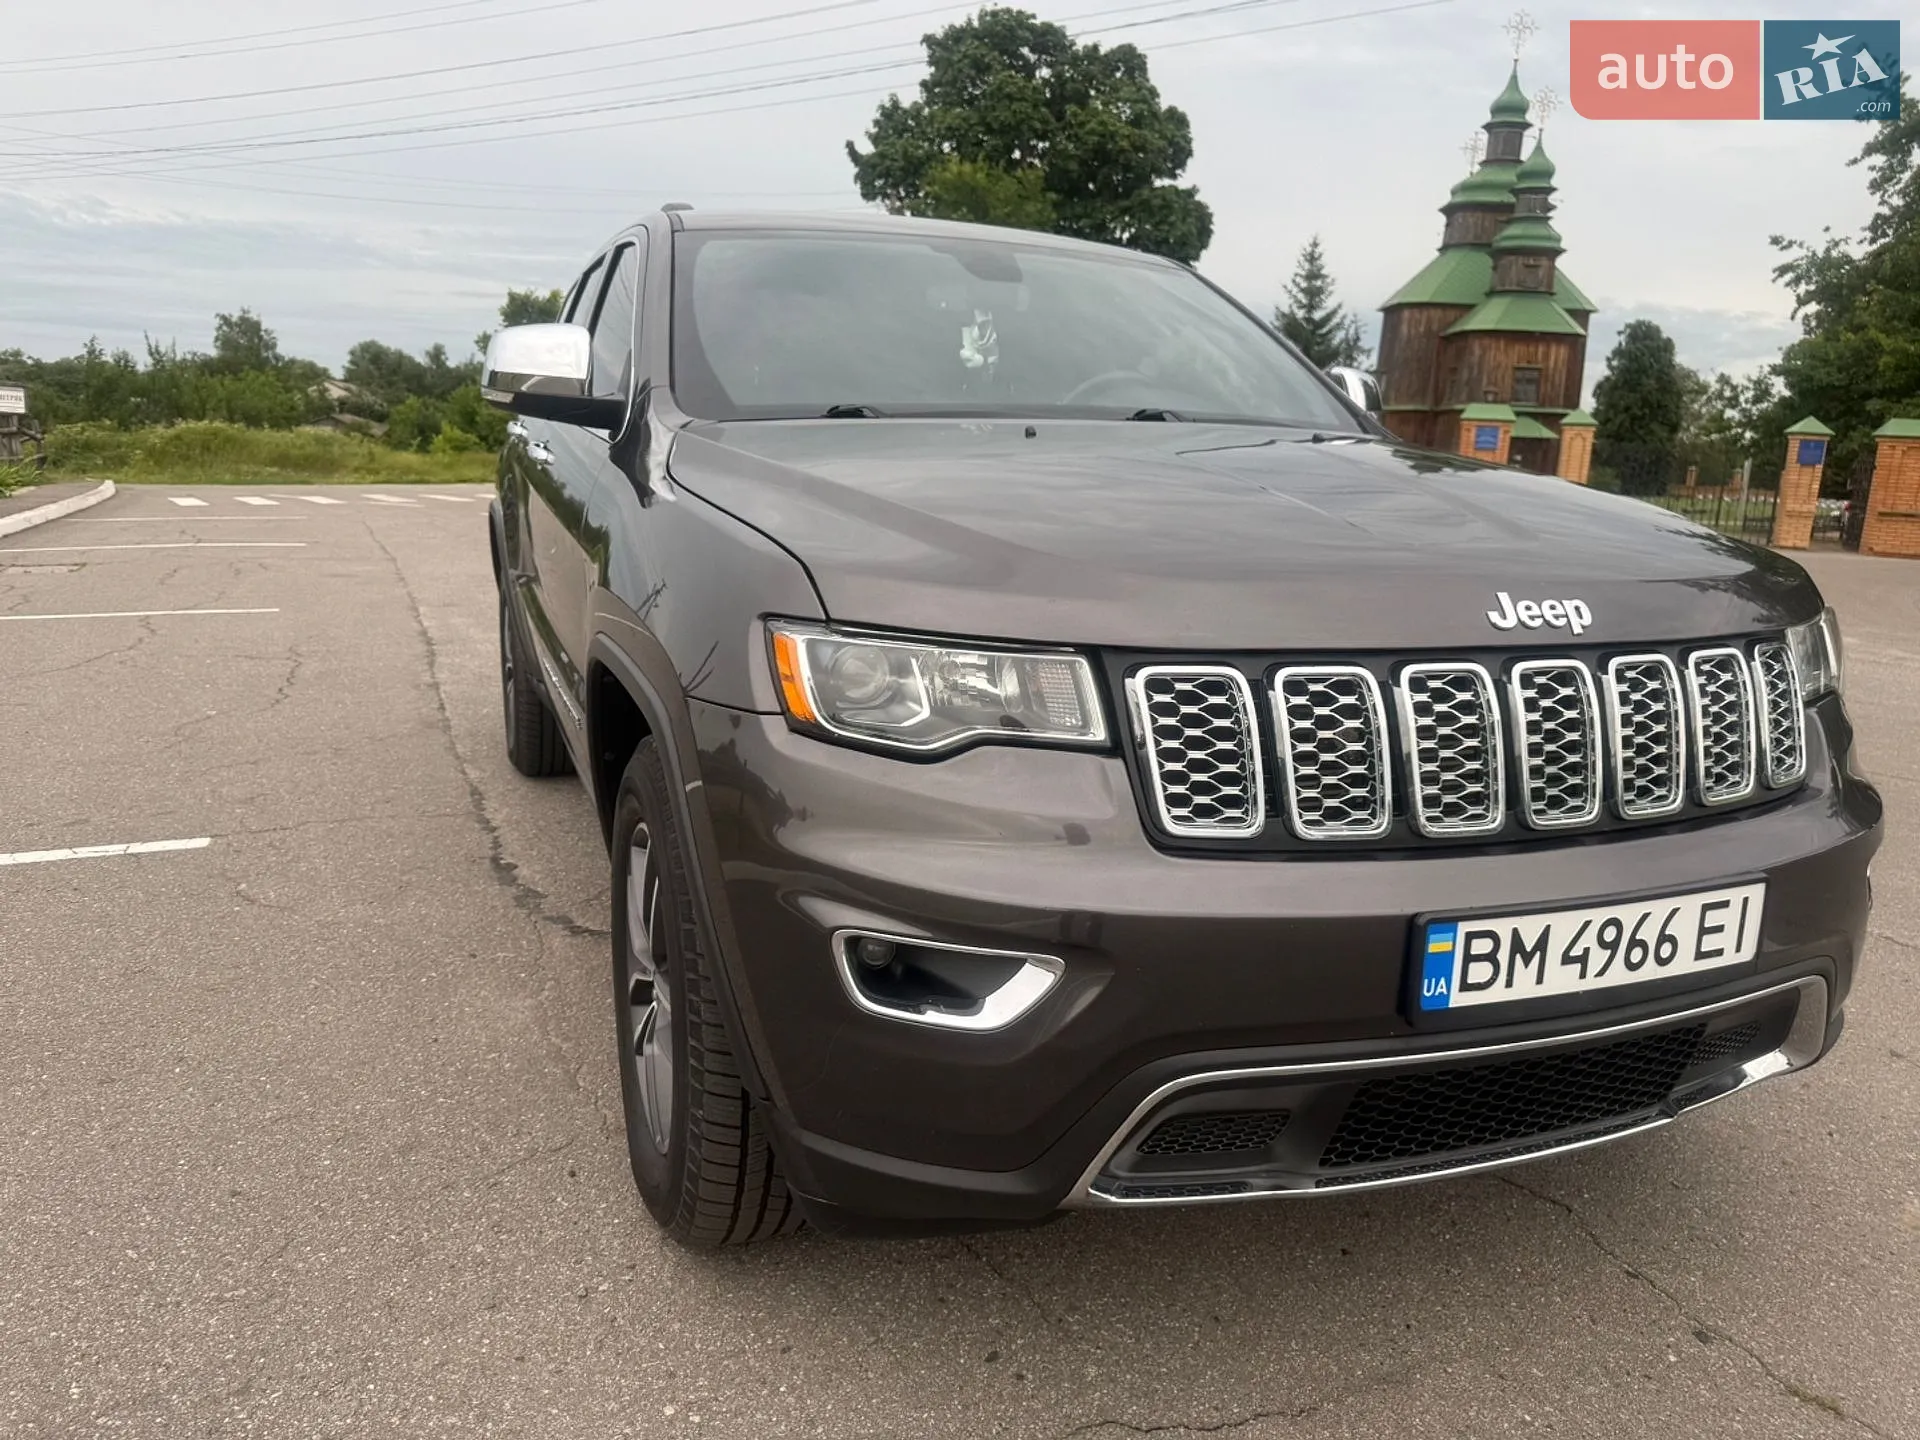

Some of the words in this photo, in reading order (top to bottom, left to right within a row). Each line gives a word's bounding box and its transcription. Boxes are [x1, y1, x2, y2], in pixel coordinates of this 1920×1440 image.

[1486, 591, 1593, 636] Jeep
[1458, 923, 1551, 993] BM
[1560, 906, 1681, 980] 4966
[1693, 895, 1751, 962] EI
[1423, 977, 1448, 997] UA
